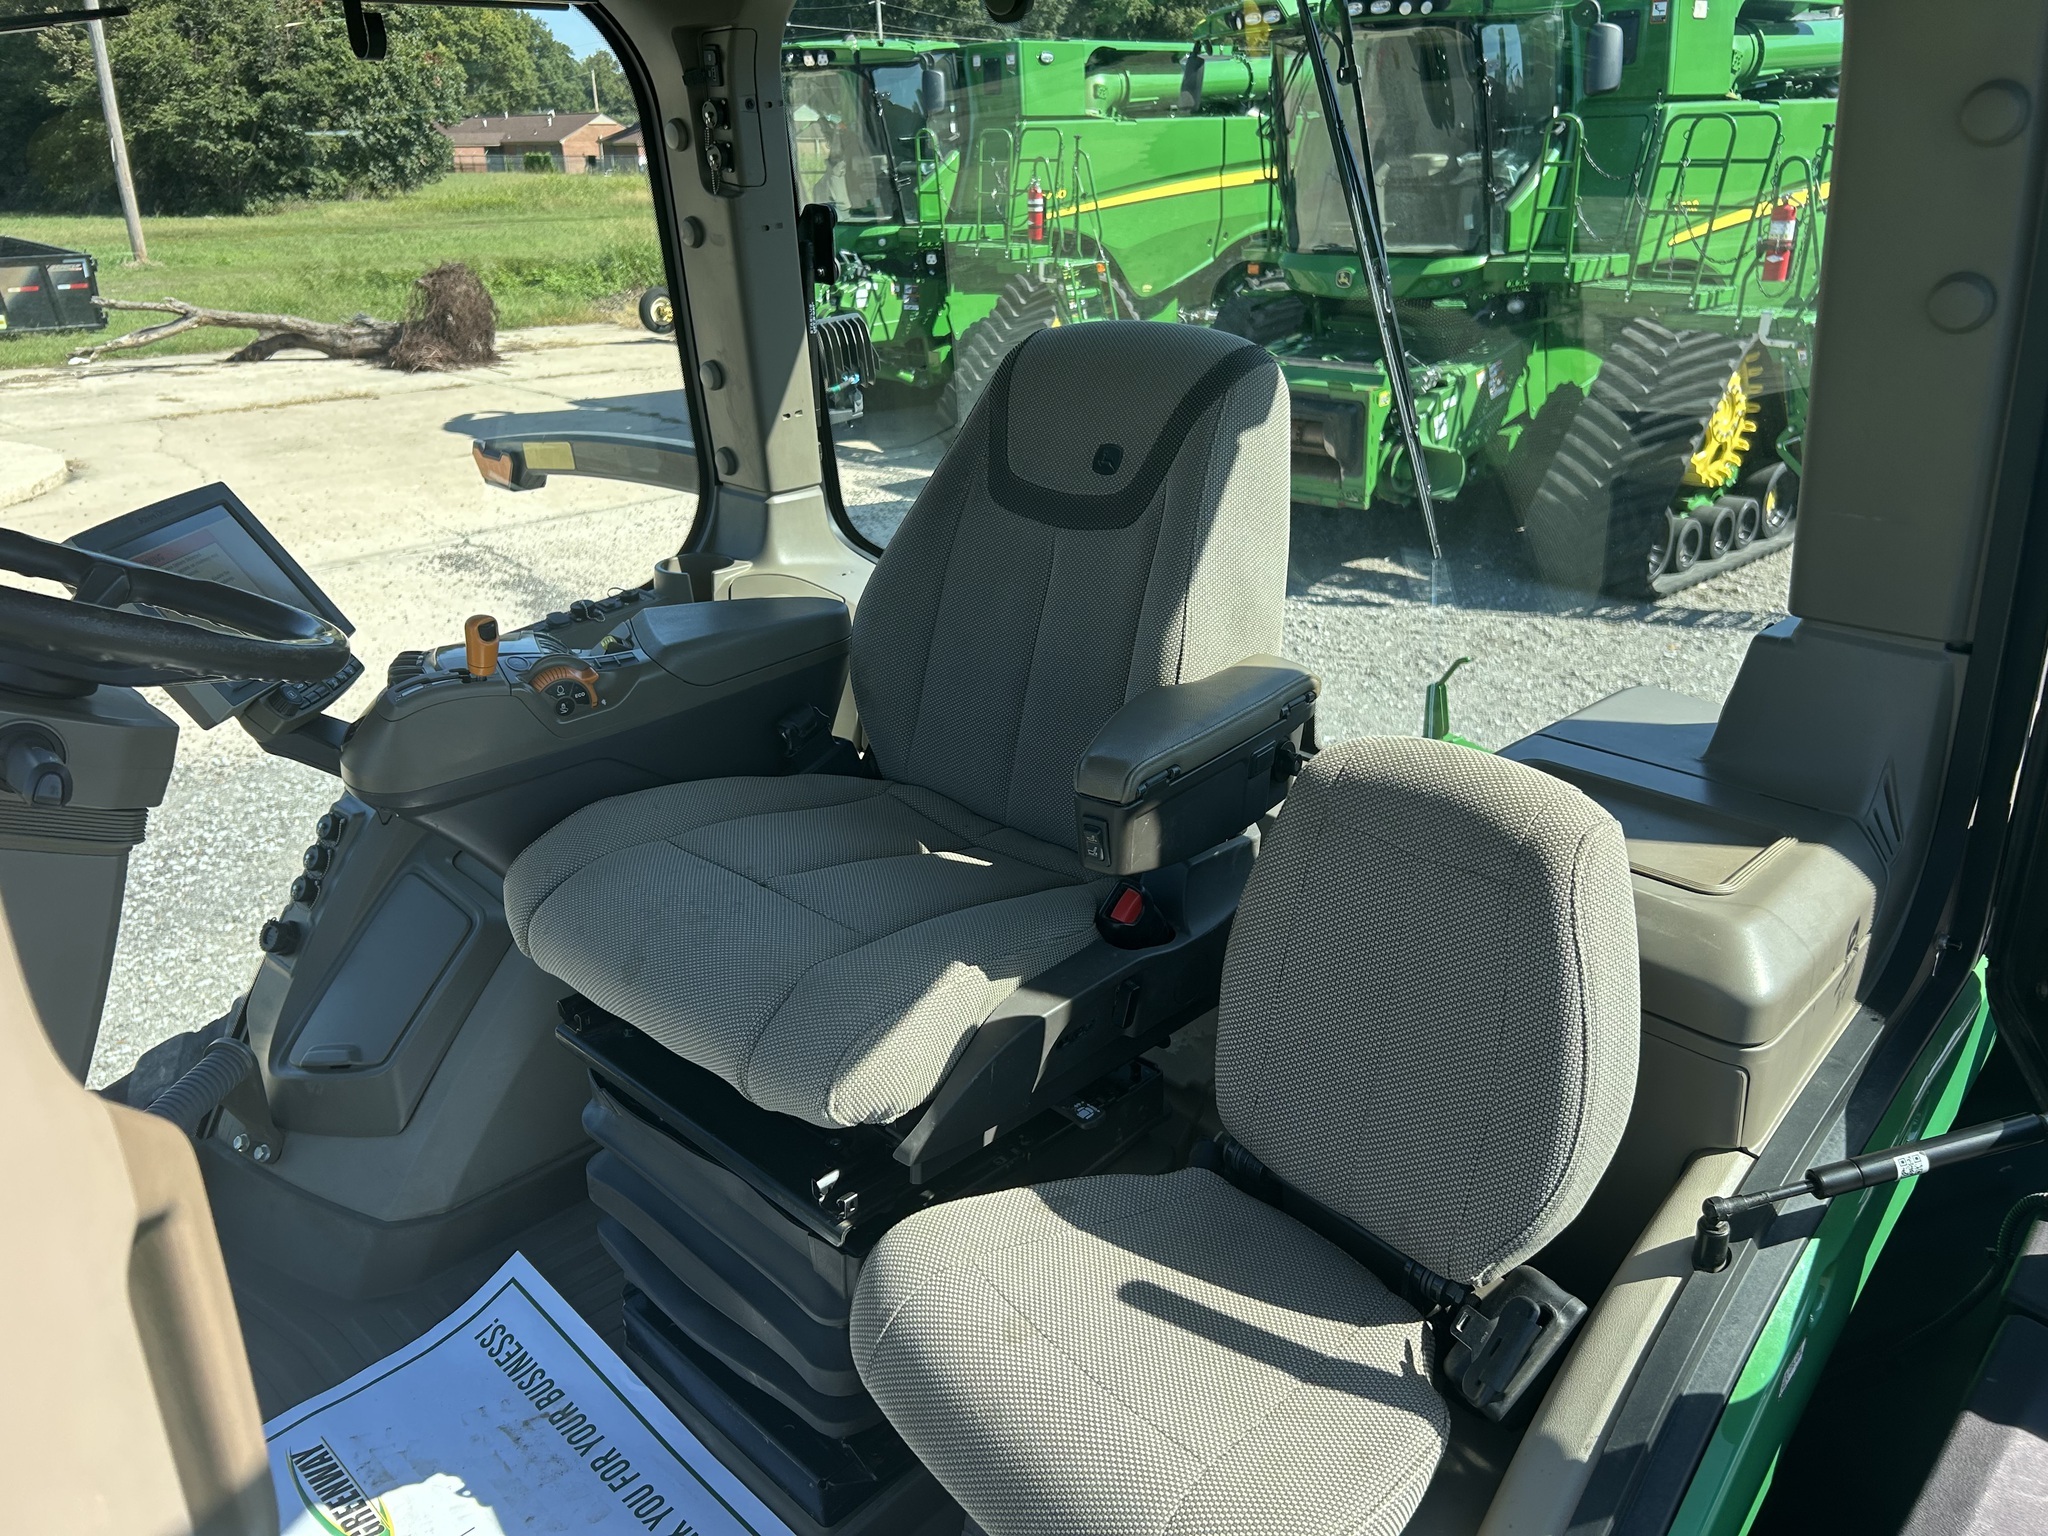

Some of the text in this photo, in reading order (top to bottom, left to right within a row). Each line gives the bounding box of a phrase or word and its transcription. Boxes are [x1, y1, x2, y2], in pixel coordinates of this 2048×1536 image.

[474, 1318, 674, 1532] YOU FOR YOUR BUSINESS!
